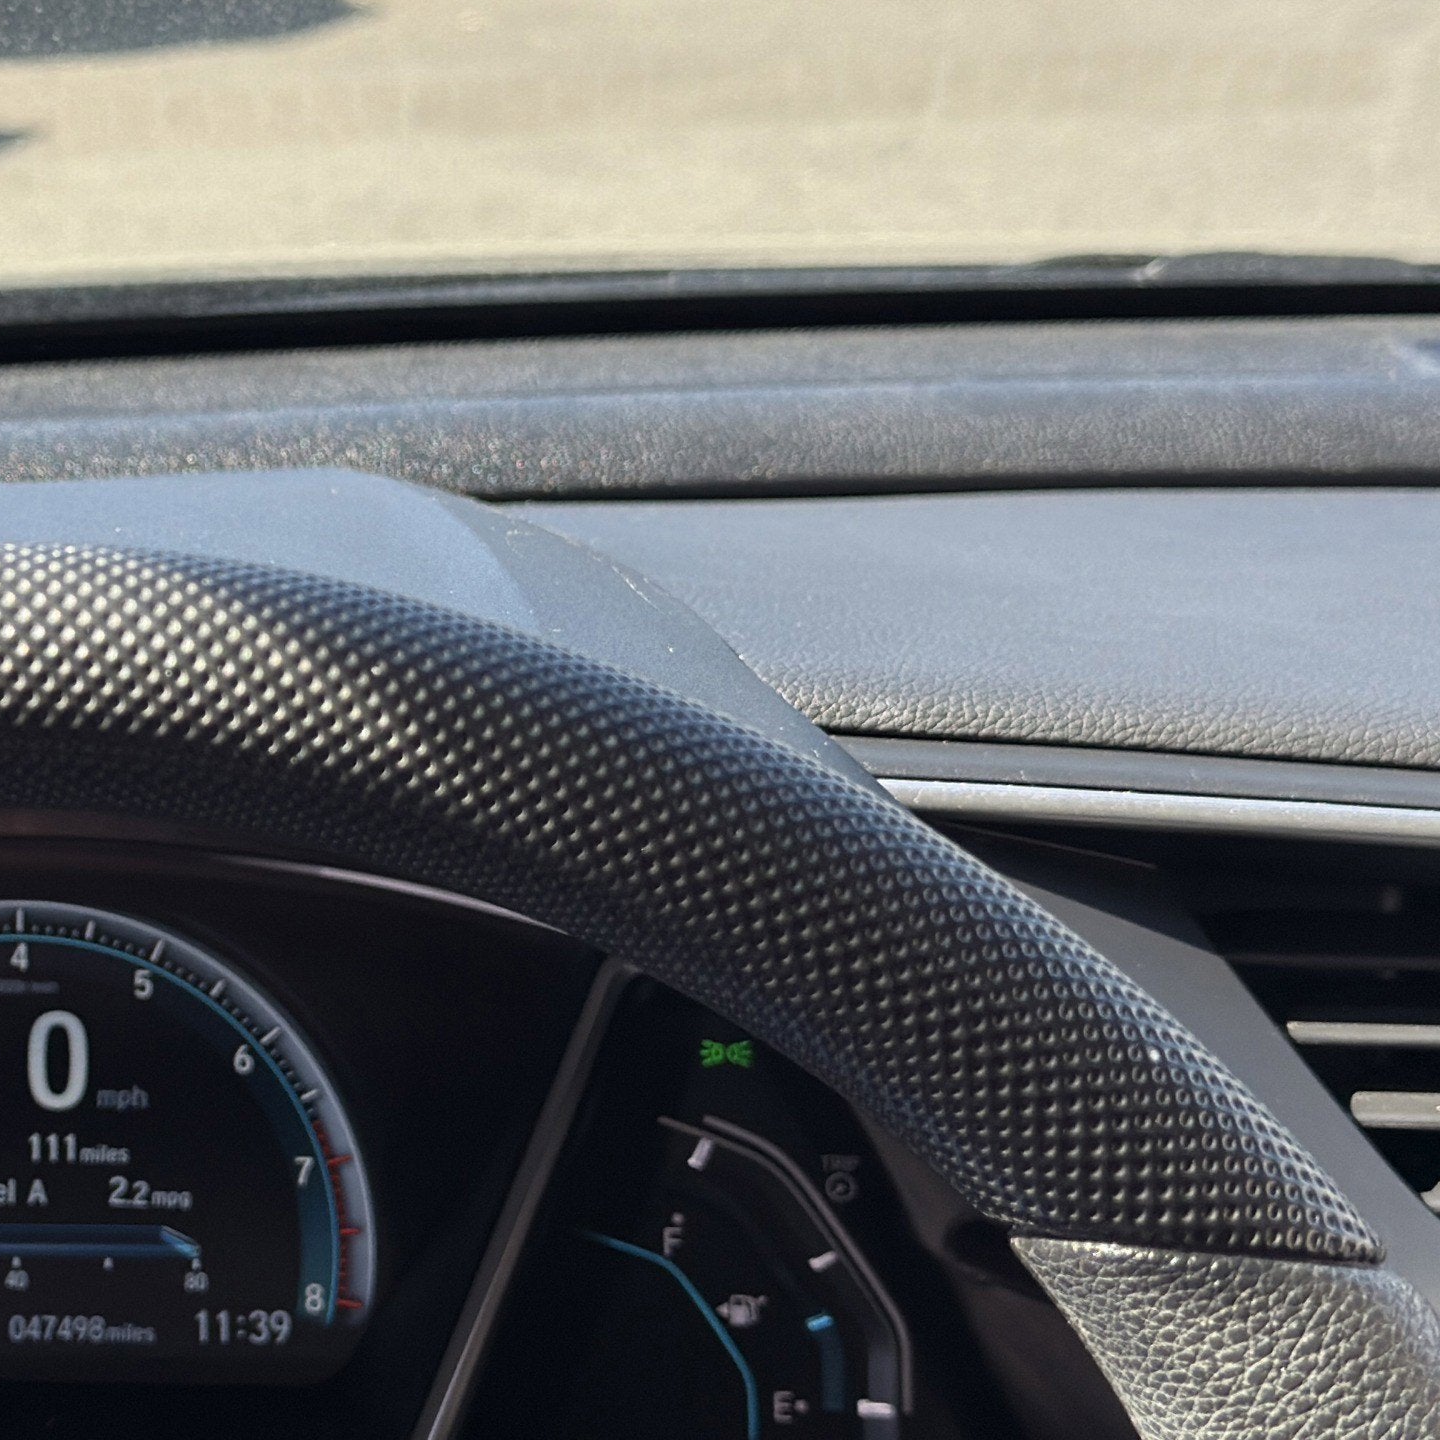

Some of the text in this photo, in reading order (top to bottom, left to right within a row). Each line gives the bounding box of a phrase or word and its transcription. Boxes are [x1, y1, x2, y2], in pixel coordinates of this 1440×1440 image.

[10, 943, 29, 971] 4
[134, 969, 153, 1000] 5
[27, 1009, 150, 1111] 0 mph
[233, 1044, 254, 1075] 6
[295, 1155, 314, 1186] 7
[27, 1178, 49, 1206] A
[663, 1226, 683, 1257] F
[304, 1283, 324, 1315] 8
[195, 1310, 293, 1346] 11:39
[773, 1391, 796, 1424] E
